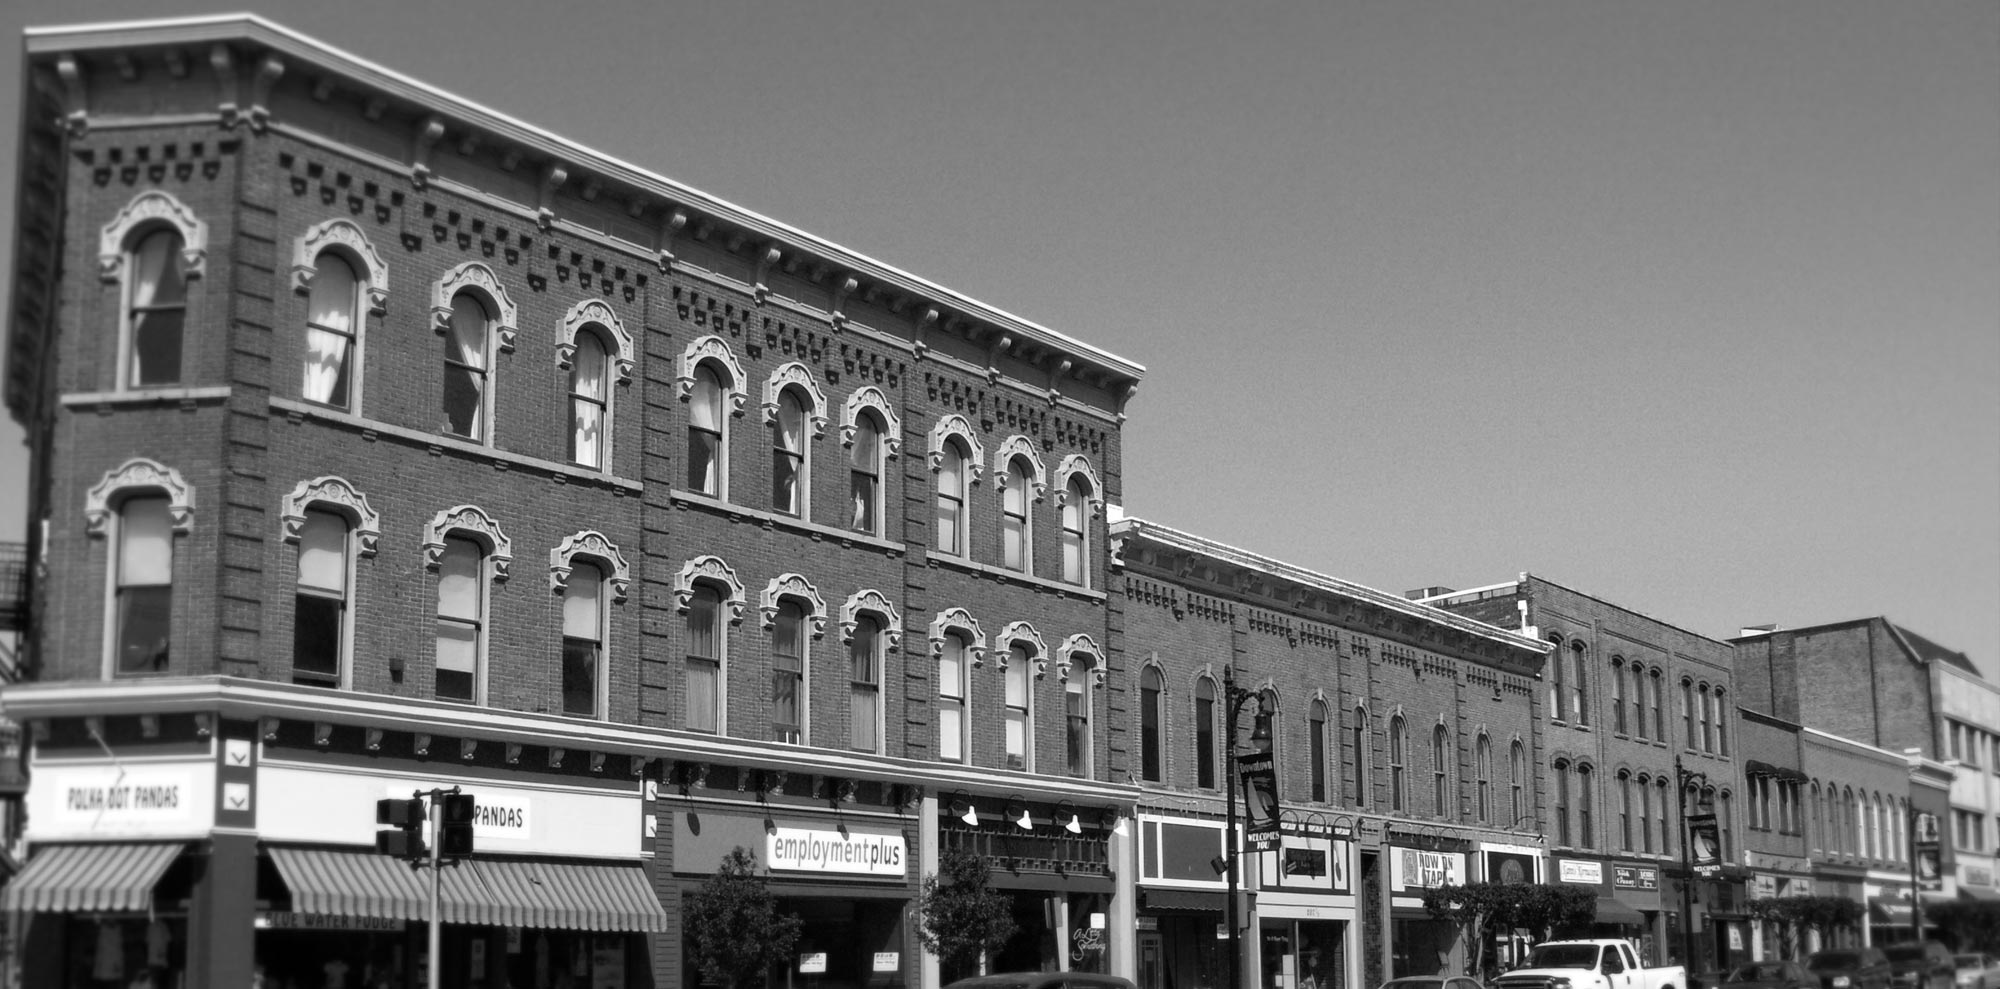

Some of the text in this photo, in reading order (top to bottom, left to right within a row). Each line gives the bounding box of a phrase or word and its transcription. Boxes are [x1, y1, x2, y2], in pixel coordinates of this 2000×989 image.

[67, 785, 179, 810] POLKA DOT PANDAS
[474, 804, 523, 828] PANDAS
[1247, 831, 1280, 842] WELCOMES
[1256, 841, 1270, 850] YOU
[304, 913, 349, 928] WATER
[355, 914, 396, 929] FUDGE
